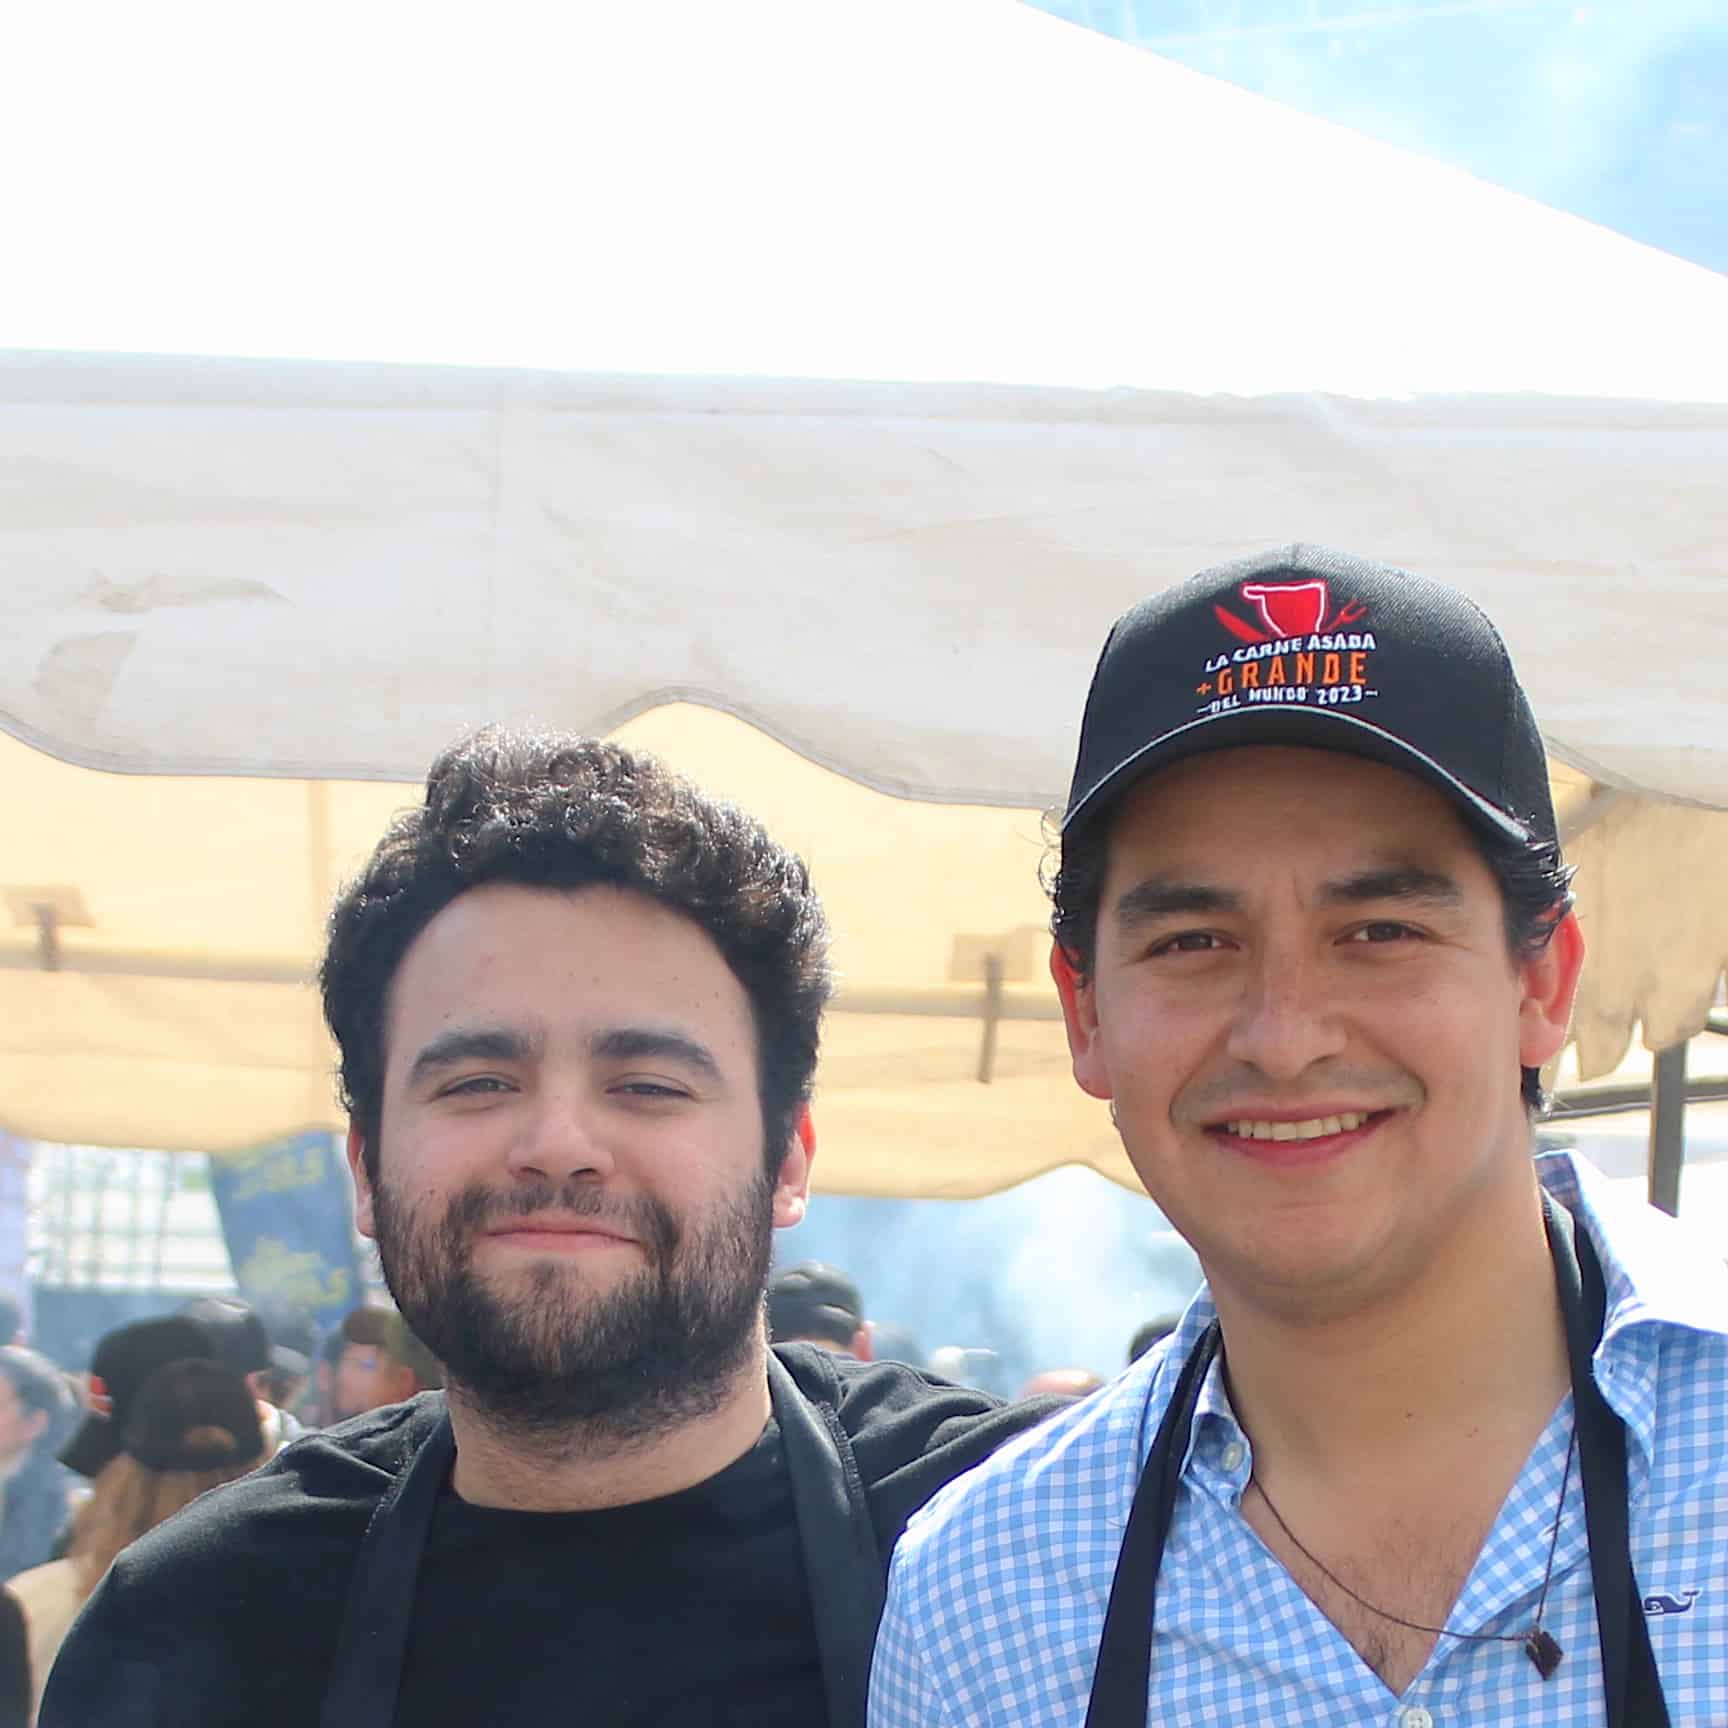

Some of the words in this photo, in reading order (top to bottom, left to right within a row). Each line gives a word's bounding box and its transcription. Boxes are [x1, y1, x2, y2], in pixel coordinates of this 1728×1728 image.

[1205, 655, 1229, 671] LA
[1233, 638, 1302, 661] CARNE
[1307, 633, 1376, 650] ASADA
[1248, 687, 1307, 701] MUNDO
